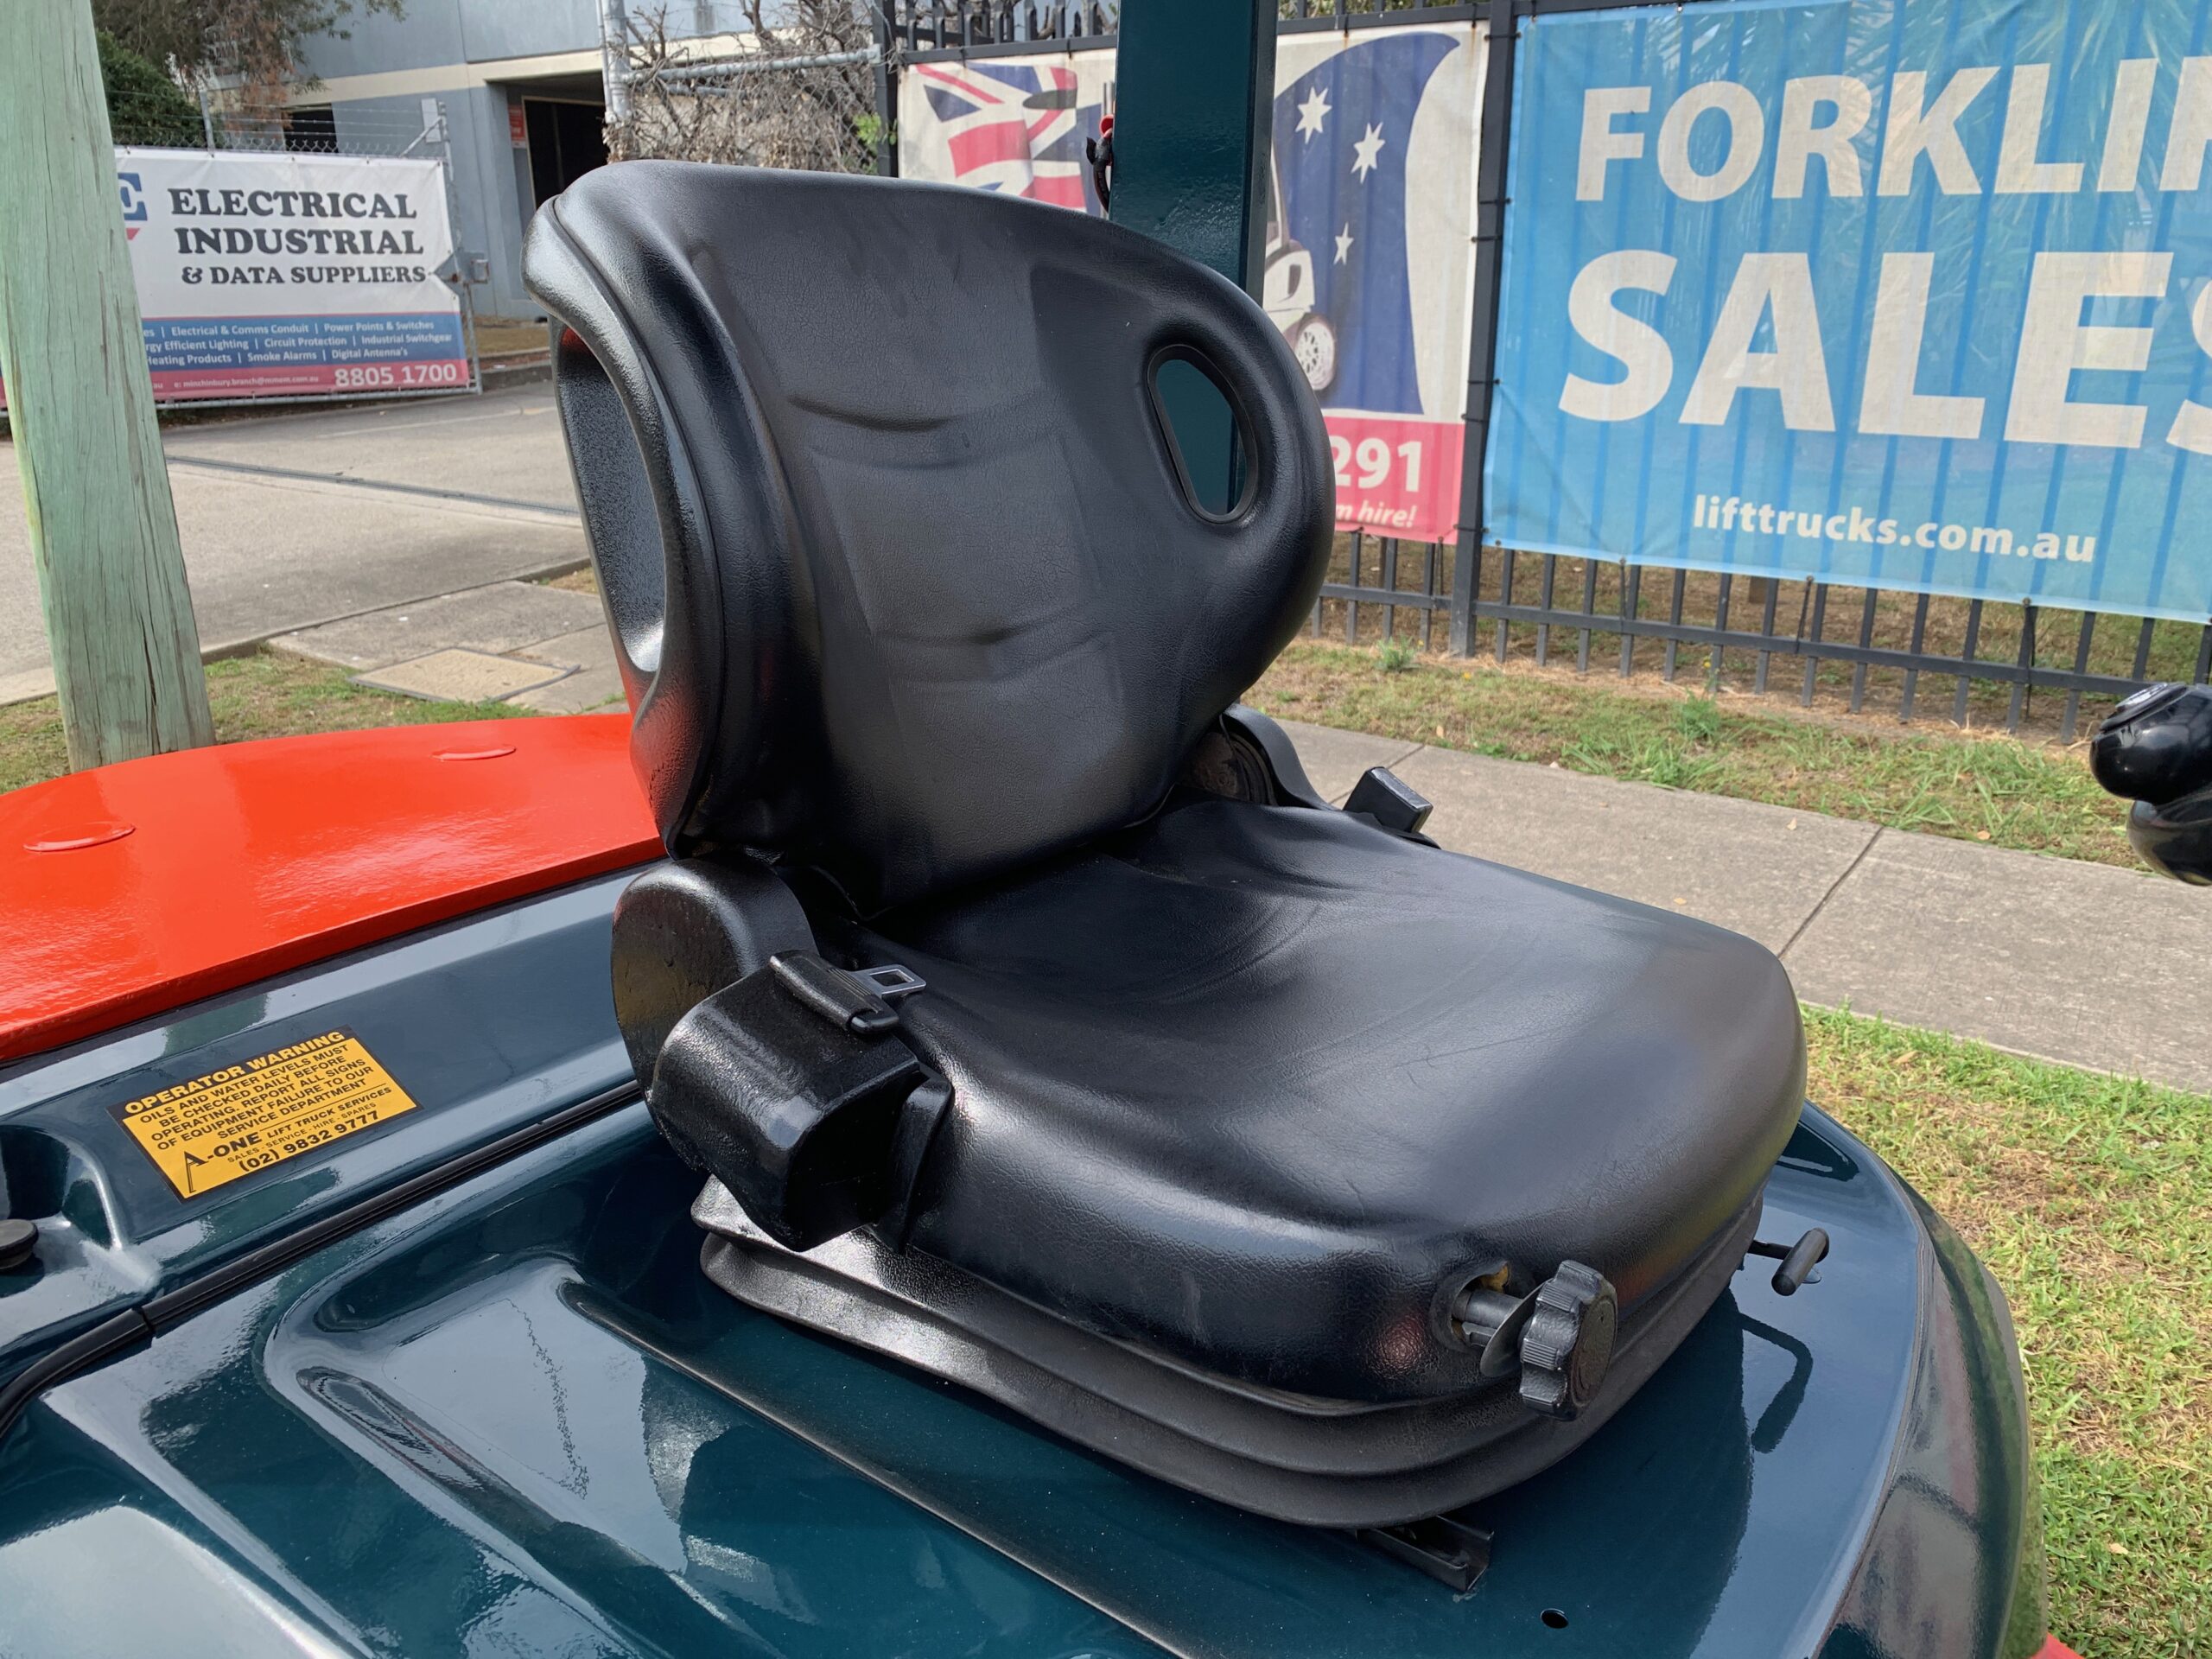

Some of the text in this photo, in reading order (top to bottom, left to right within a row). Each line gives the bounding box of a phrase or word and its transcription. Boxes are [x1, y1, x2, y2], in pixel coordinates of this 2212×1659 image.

[168, 188, 417, 219] ELECTRICAL
[174, 227, 424, 254] INDUSTRIAL
[181, 266, 426, 284] & DATA SUPPLIERS
[165, 340, 207, 351] Efficient
[209, 339, 249, 351] Lighting
[264, 337, 296, 347] Circuit
[298, 336, 346, 346] Protection
[361, 334, 404, 345] Industrial
[405, 333, 452, 344] Switchgear
[171, 325, 218, 336] Electrical
[220, 325, 230, 335] &
[232, 325, 269, 335] Comms
[270, 323, 308, 334] Conduit
[323, 322, 353, 333] Power
[356, 321, 384, 332] Points
[386, 321, 394, 330] &
[395, 320, 434, 330] Switches
[188, 353, 232, 364] Products
[247, 352, 280, 362] Smoke
[283, 351, 317, 361] Alarms
[331, 348, 360, 359] Digital
[363, 347, 408, 358] Antenna's
[334, 364, 456, 387] 8805 1700
[1357, 499, 1417, 528] hire!
[1694, 494, 2096, 563] lifttrucks.com.au
[124, 1032, 345, 1114] OPERATOR WARNING
[140, 1044, 349, 1123] OILS AND WATER LEVELS MUST
[151, 1058, 366, 1141] OPERATING. REPORT ALL SIGNS
[158, 1055, 347, 1128] BE CHECKED DAILY BEFORE
[157, 1066, 374, 1150] OF EQUIPMENT FAILURE TO OUR
[217, 1078, 366, 1139] SERVICE DEPARTMENT
[227, 1147, 259, 1163] SALES
[265, 1128, 308, 1148] SERVICE
[313, 1117, 335, 1130] HIRE
[341, 1103, 376, 1118] SPARES
[266, 1124, 292, 1138] LIFT
[295, 1109, 335, 1127] TRUCK
[337, 1087, 392, 1111] SERVICES
[239, 1110, 378, 1172] (02) 9832 9777
